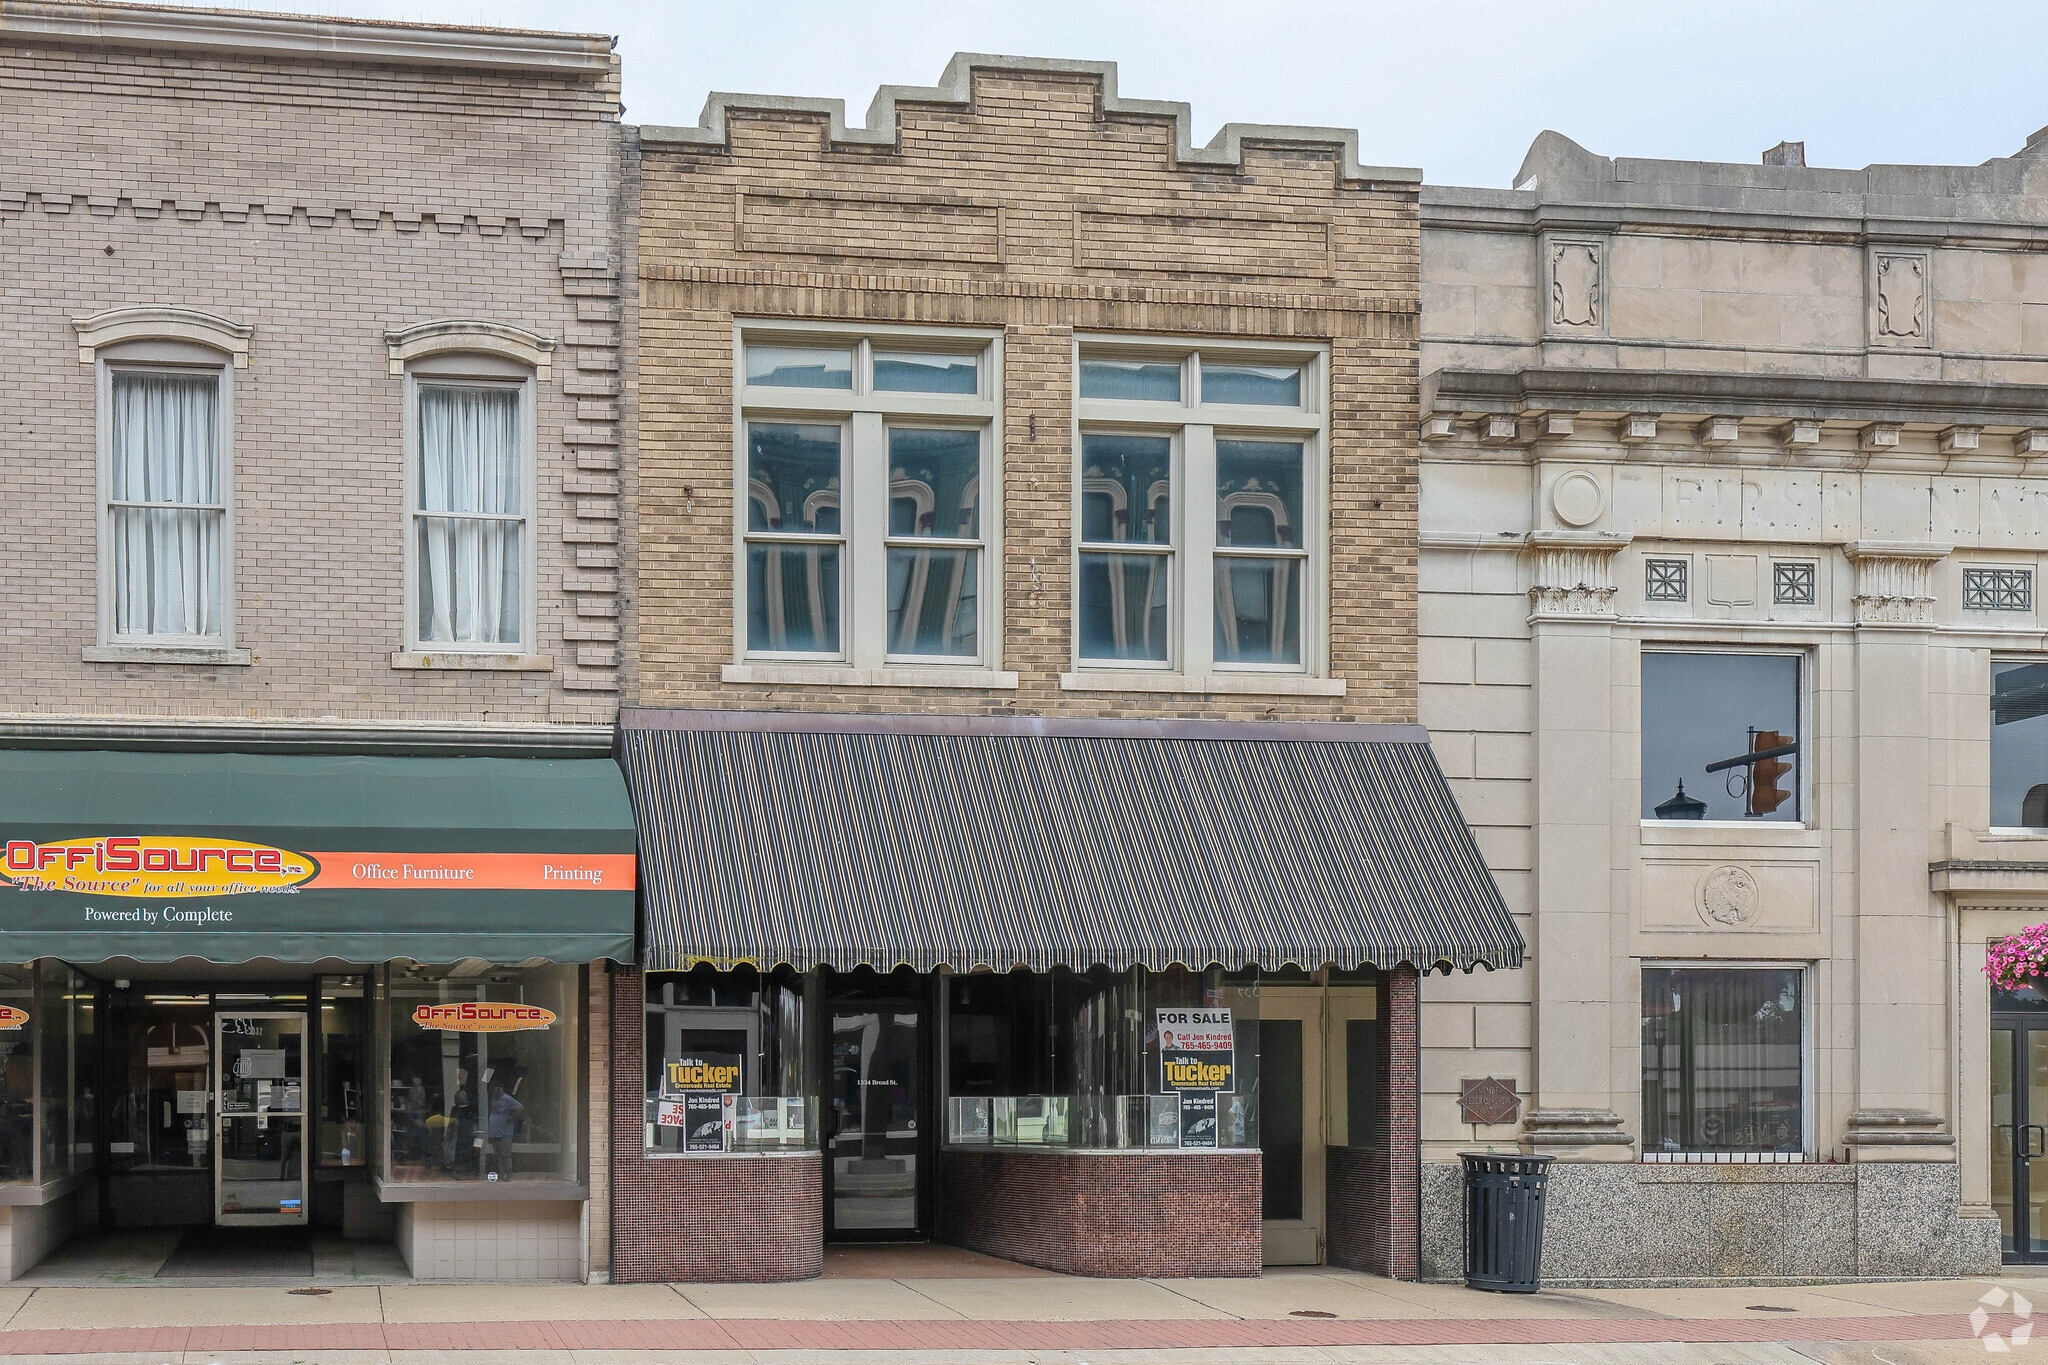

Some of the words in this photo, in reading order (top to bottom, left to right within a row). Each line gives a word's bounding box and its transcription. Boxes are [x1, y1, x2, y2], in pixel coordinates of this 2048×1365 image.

[352, 863, 399, 880] Office
[402, 863, 475, 880] Furniture
[543, 864, 604, 886] Printing
[12, 876, 56, 892] "The
[63, 875, 140, 893] Source"
[143, 881, 163, 895] for
[167, 882, 185, 893] all
[188, 884, 219, 896] your
[221, 882, 257, 896] office
[85, 907, 141, 922] Powered
[143, 907, 158, 925] by
[163, 906, 233, 926] Complete
[1158, 1013, 1188, 1024] FOR
[1192, 1013, 1230, 1024] SALE
[1177, 1033, 1191, 1041] Call
[1193, 1033, 1204, 1041] Jon
[1206, 1033, 1232, 1041] Kindred
[1181, 1041, 1233, 1050] 765-465-9409
[679, 1058, 694, 1067] Talk
[695, 1058, 703, 1067] to
[1175, 1057, 1189, 1065] Talk
[1190, 1057, 1198, 1065] to
[667, 1063, 739, 1084] Tucker
[1164, 1061, 1231, 1082] Tucker
[688, 1096, 698, 1104] Jon
[699, 1096, 720, 1104] Kindred
